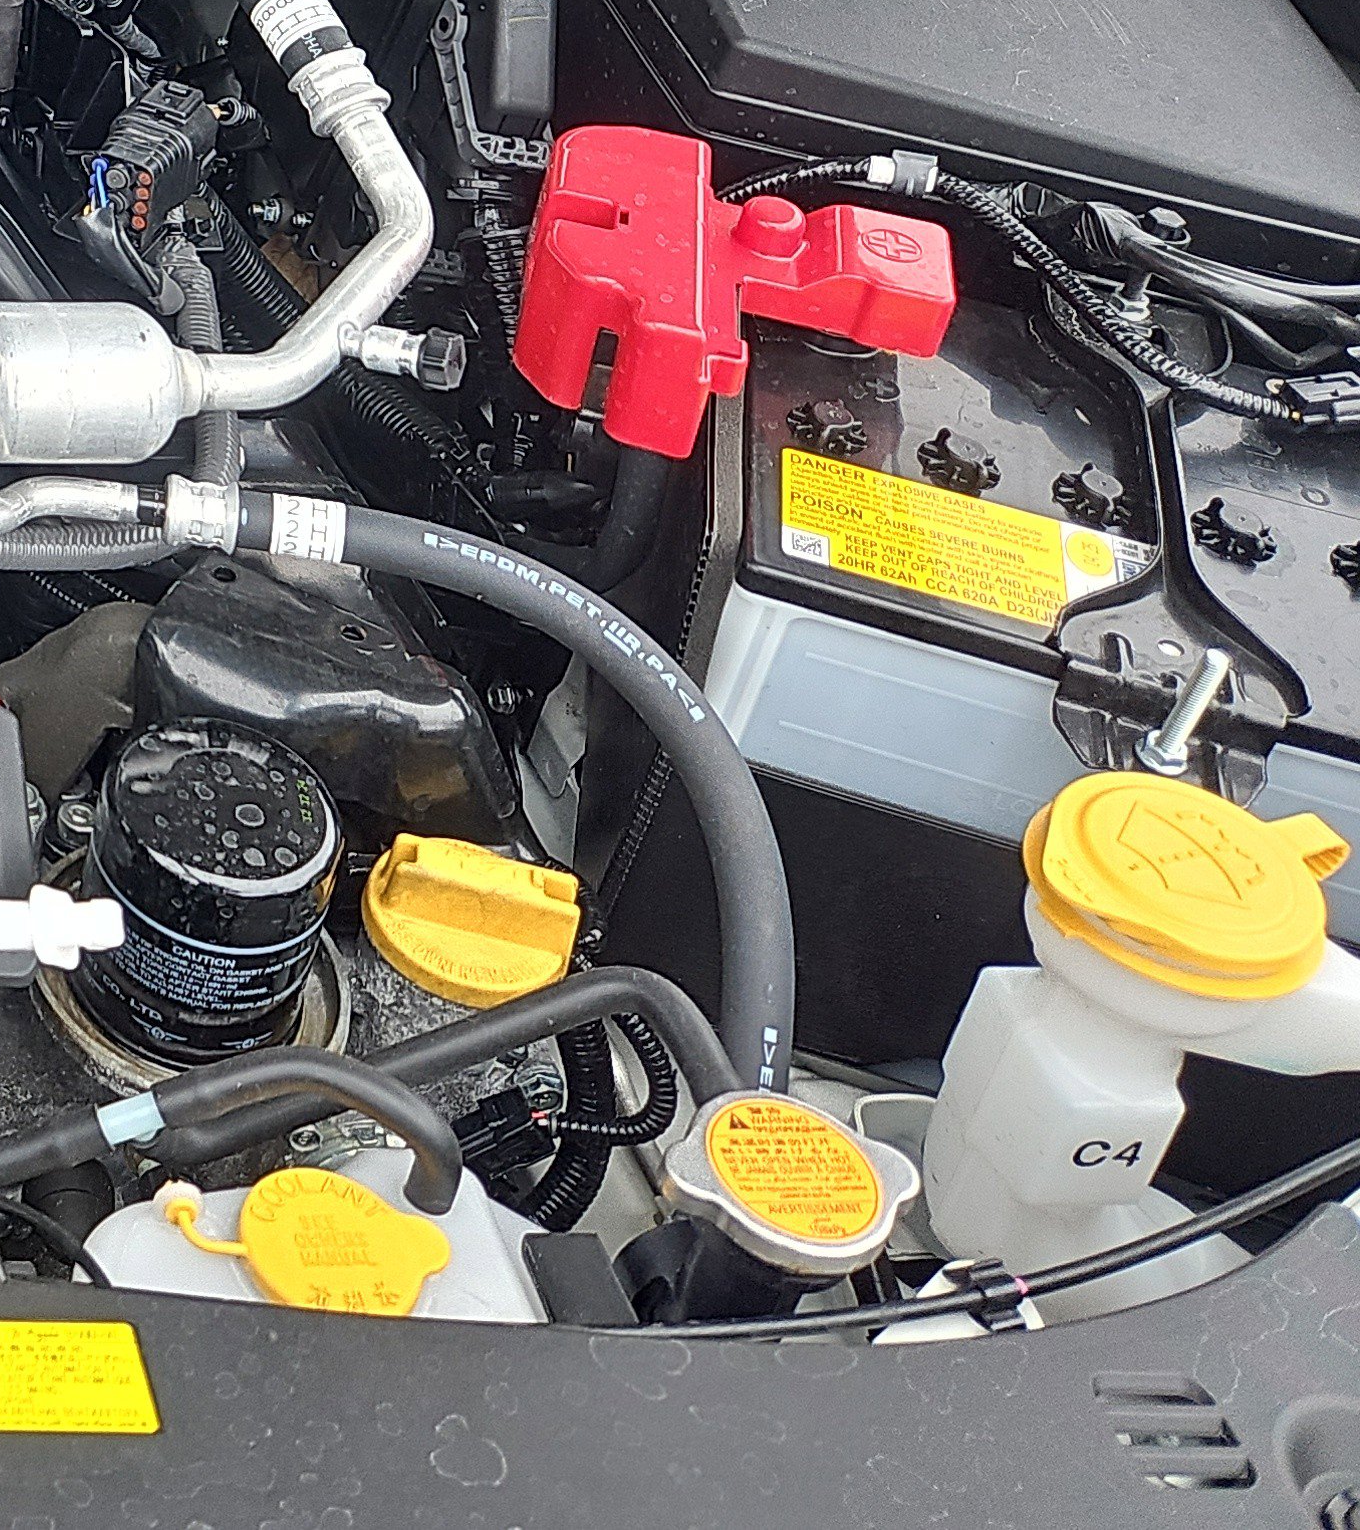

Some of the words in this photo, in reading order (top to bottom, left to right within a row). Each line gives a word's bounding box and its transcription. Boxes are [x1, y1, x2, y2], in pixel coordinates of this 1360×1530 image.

[790, 453, 865, 482] DANGER
[873, 476, 940, 502] EXPLOSIVE
[944, 495, 986, 514] GASES
[287, 499, 300, 515] 2
[311, 501, 328, 519] H
[286, 520, 299, 538] 2
[310, 523, 327, 542] H
[790, 492, 863, 520] POISON
[875, 516, 925, 536] CAUSES
[929, 530, 978, 551] SEVERE
[982, 544, 1026, 564] BURNS
[838, 553, 876, 573] 20HR
[880, 566, 917, 585] 62Ah
[925, 577, 959, 597] CCA
[963, 588, 999, 609] 620A
[845, 534, 878, 550] KEEP
[882, 544, 913, 560] VENT
[916, 553, 951, 570] CAPS
[955, 565, 991, 581] TIGHT
[995, 575, 1021, 590] AND
[1025, 583, 1064, 602] LEVEL
[846, 543, 878, 560] KEEP
[882, 553, 907, 568] OUT
[911, 562, 928, 574] OF
[932, 567, 975, 587] REACH
[979, 580, 996, 593] OF
[165, 960, 211, 981] CONTACT
[172, 946, 237, 969] CAUTION
[168, 991, 210, 1009] MANUAL
[210, 1003, 231, 1011] FOR
[201, 986, 232, 998] START
[1072, 1140, 1143, 1168] C4
[249, 1173, 388, 1223] COOLANT
